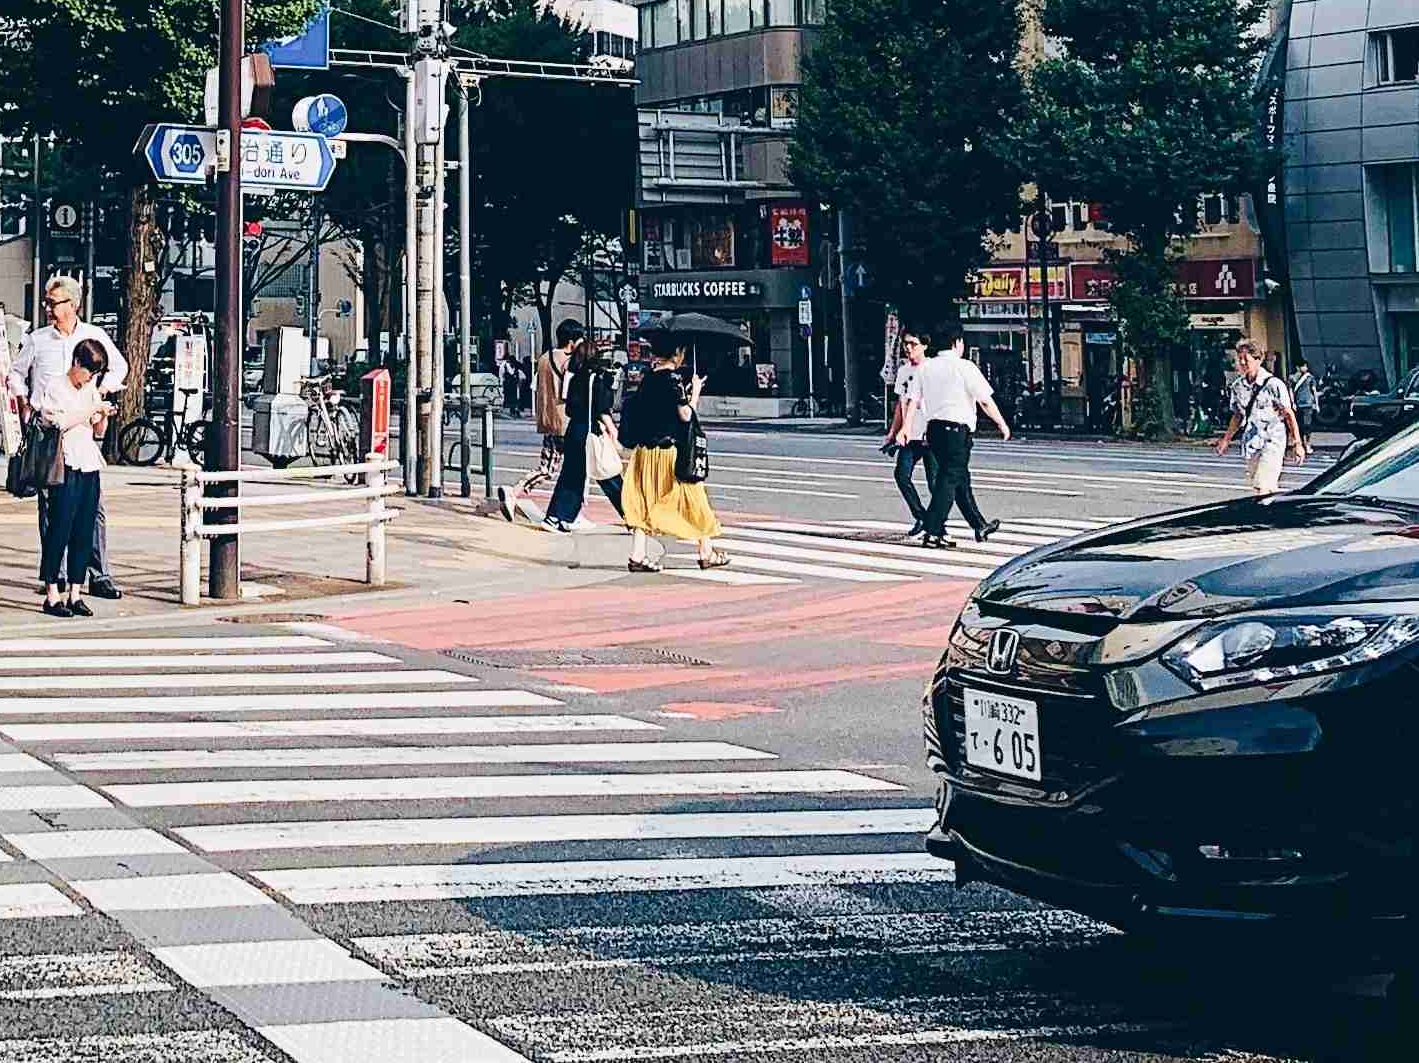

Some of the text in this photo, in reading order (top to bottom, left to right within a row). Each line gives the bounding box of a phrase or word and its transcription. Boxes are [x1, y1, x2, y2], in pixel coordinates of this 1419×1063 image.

[172, 142, 201, 165] 305
[280, 167, 301, 180] Ave
[653, 282, 700, 297] STARBUCKS
[703, 281, 746, 297] COFFEE
[1001, 702, 1021, 725] 332
